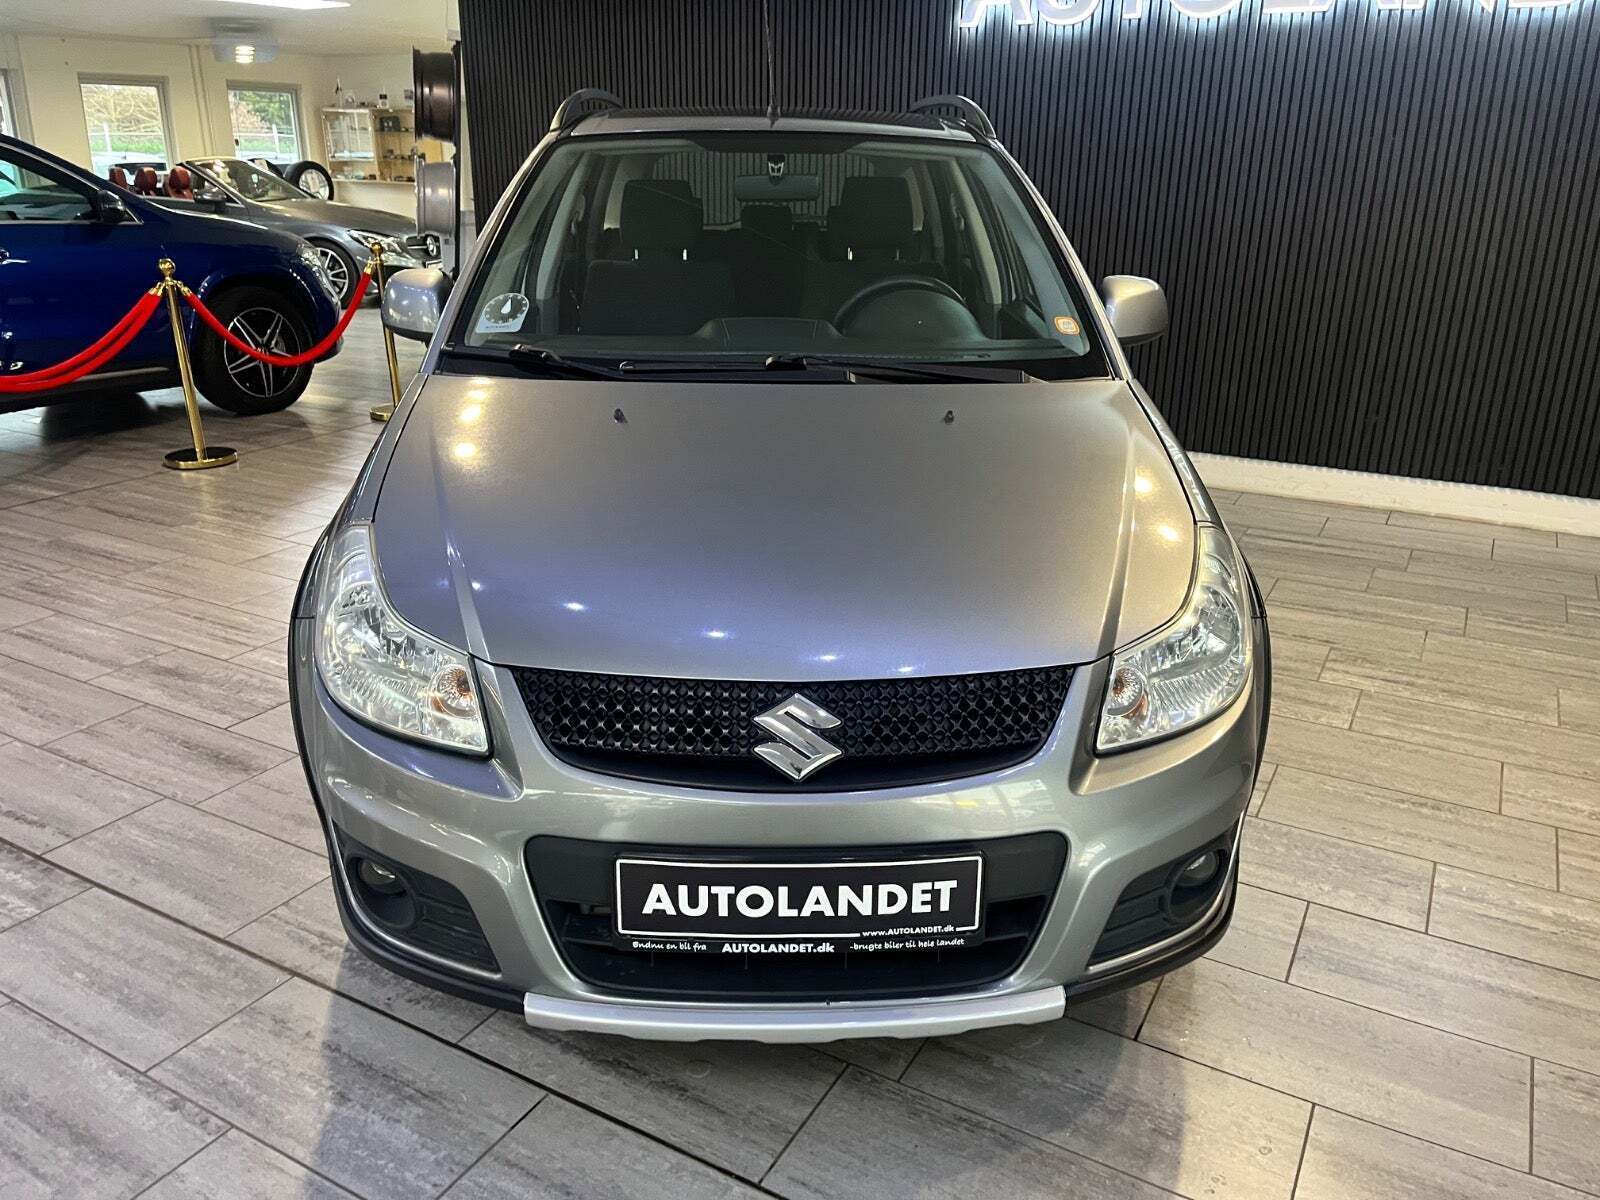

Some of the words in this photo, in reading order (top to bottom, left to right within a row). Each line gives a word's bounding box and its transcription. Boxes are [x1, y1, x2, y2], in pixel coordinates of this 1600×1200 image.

[642, 880, 957, 917] AUTOLANDET
[862, 925, 955, 937] www.AUTOLANDET.dk
[693, 942, 707, 952] fra
[721, 942, 835, 953] AUTOLANDET.dk
[884, 941, 904, 950] biler
[905, 939, 917, 948] til
[918, 939, 936, 948] hele
[937, 937, 965, 947] landet
